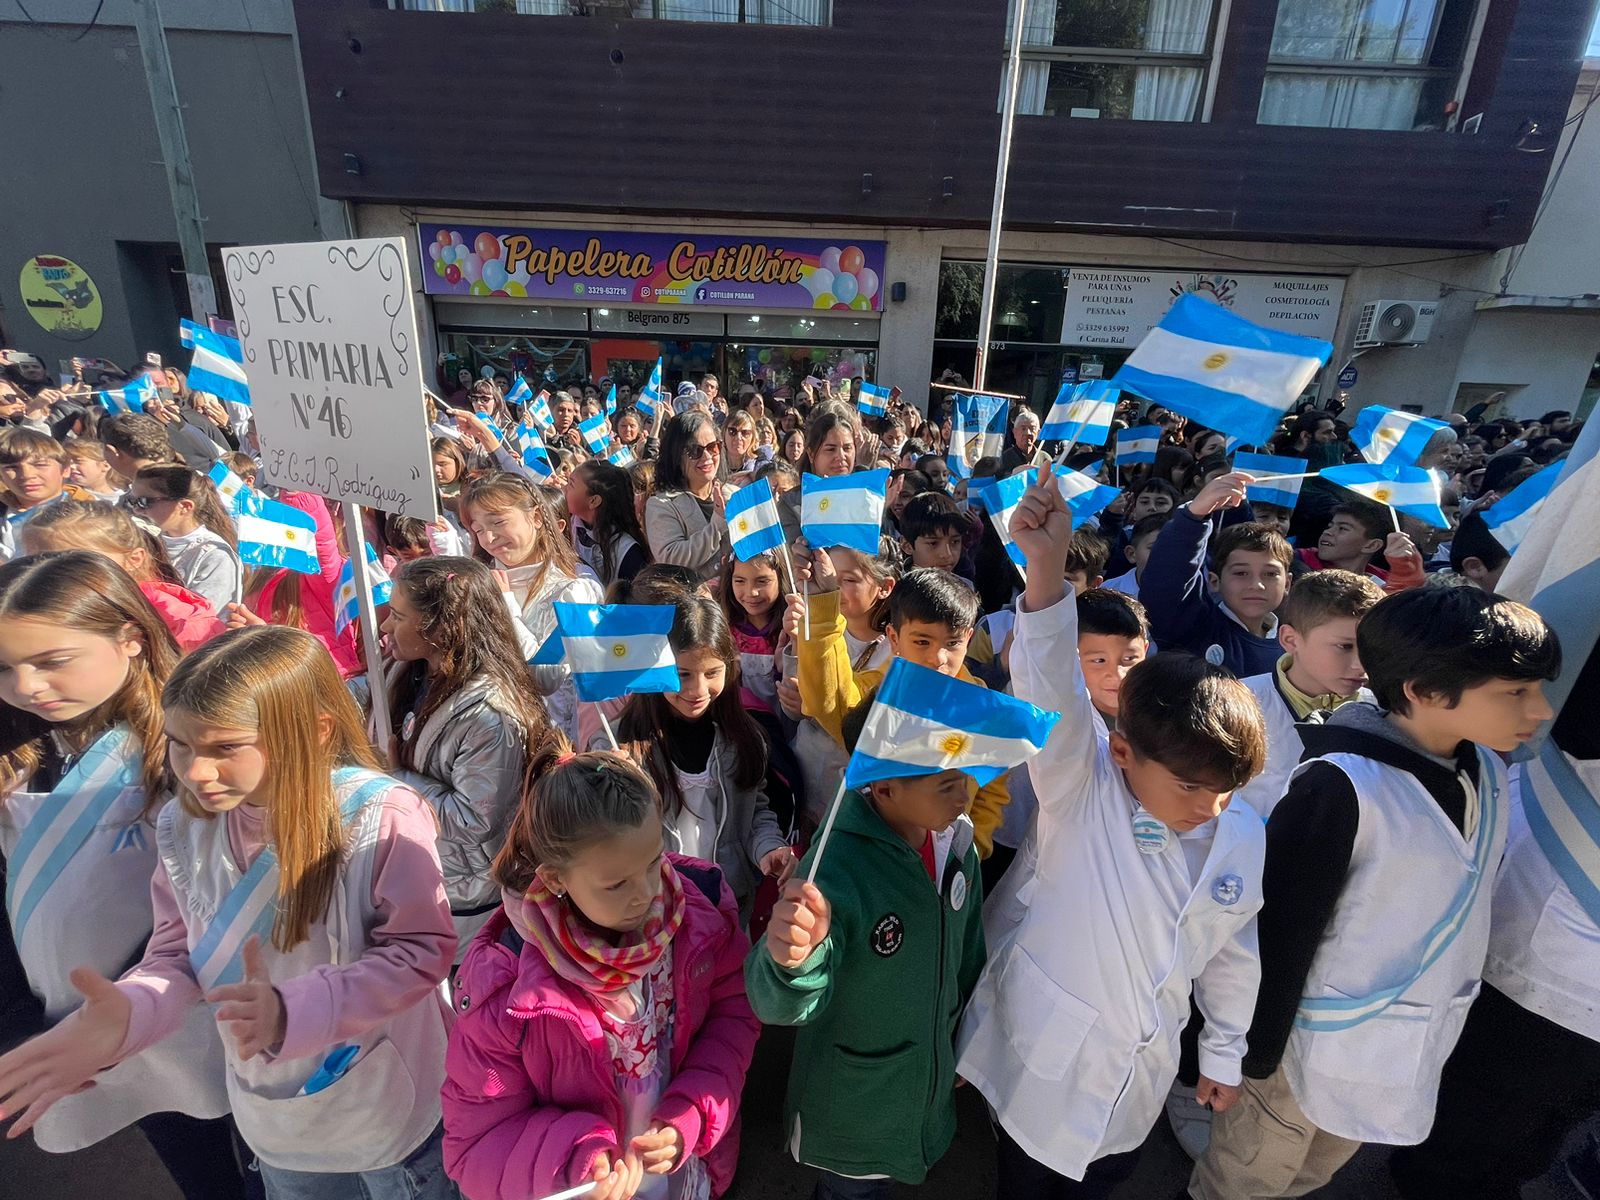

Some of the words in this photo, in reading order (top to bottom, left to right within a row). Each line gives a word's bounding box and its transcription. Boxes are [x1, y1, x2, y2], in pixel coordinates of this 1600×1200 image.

[503, 235, 653, 285] Papelera
[668, 241, 803, 285] Cotillón
[1072, 273, 1099, 281] VENTA
[1111, 274, 1151, 283] INSUMOS
[1088, 282, 1108, 290] PARA
[1273, 282, 1329, 292] MAQUILLAJES
[272, 284, 332, 324] ESC.
[1265, 297, 1330, 306] COSMETOLOGÍA
[628, 311, 670, 326] Belgrano
[673, 313, 690, 325] 875
[1269, 311, 1319, 320] DEPILACIÓN
[990, 341, 1005, 350] 873
[268, 339, 394, 389] PRIMARIA
